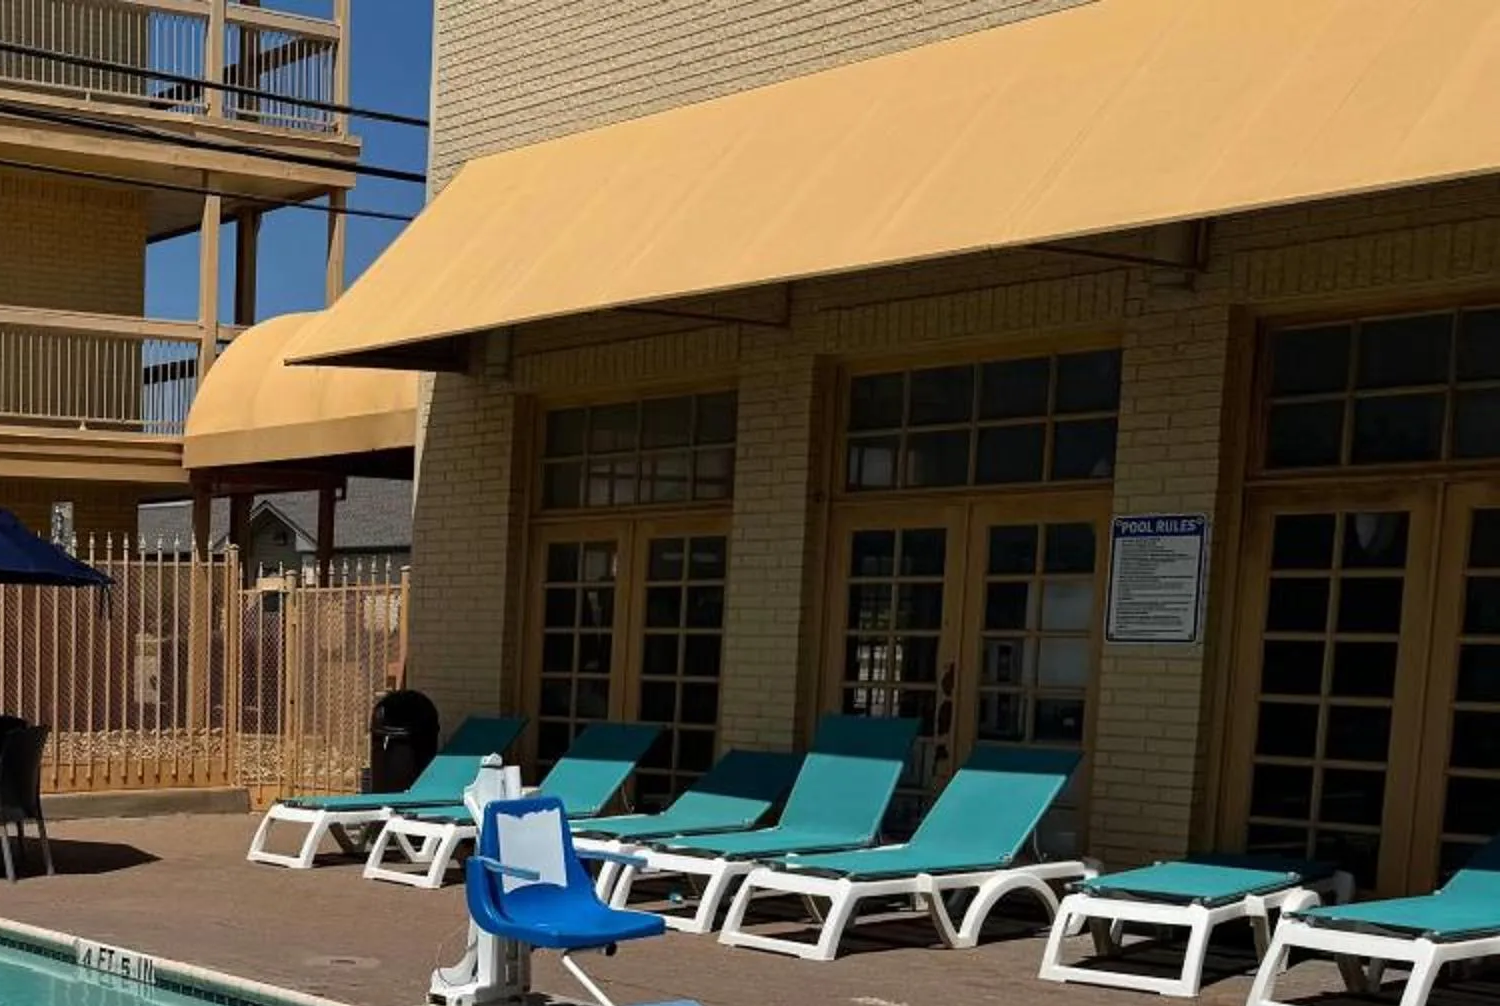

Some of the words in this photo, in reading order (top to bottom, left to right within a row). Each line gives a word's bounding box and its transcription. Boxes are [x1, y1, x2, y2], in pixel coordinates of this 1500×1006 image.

[1120, 520, 1154, 534] POOL
[1155, 519, 1197, 534] RULES
[98, 947, 115, 971] FT
[121, 956, 131, 976] 5
[137, 956, 153, 983] IN
